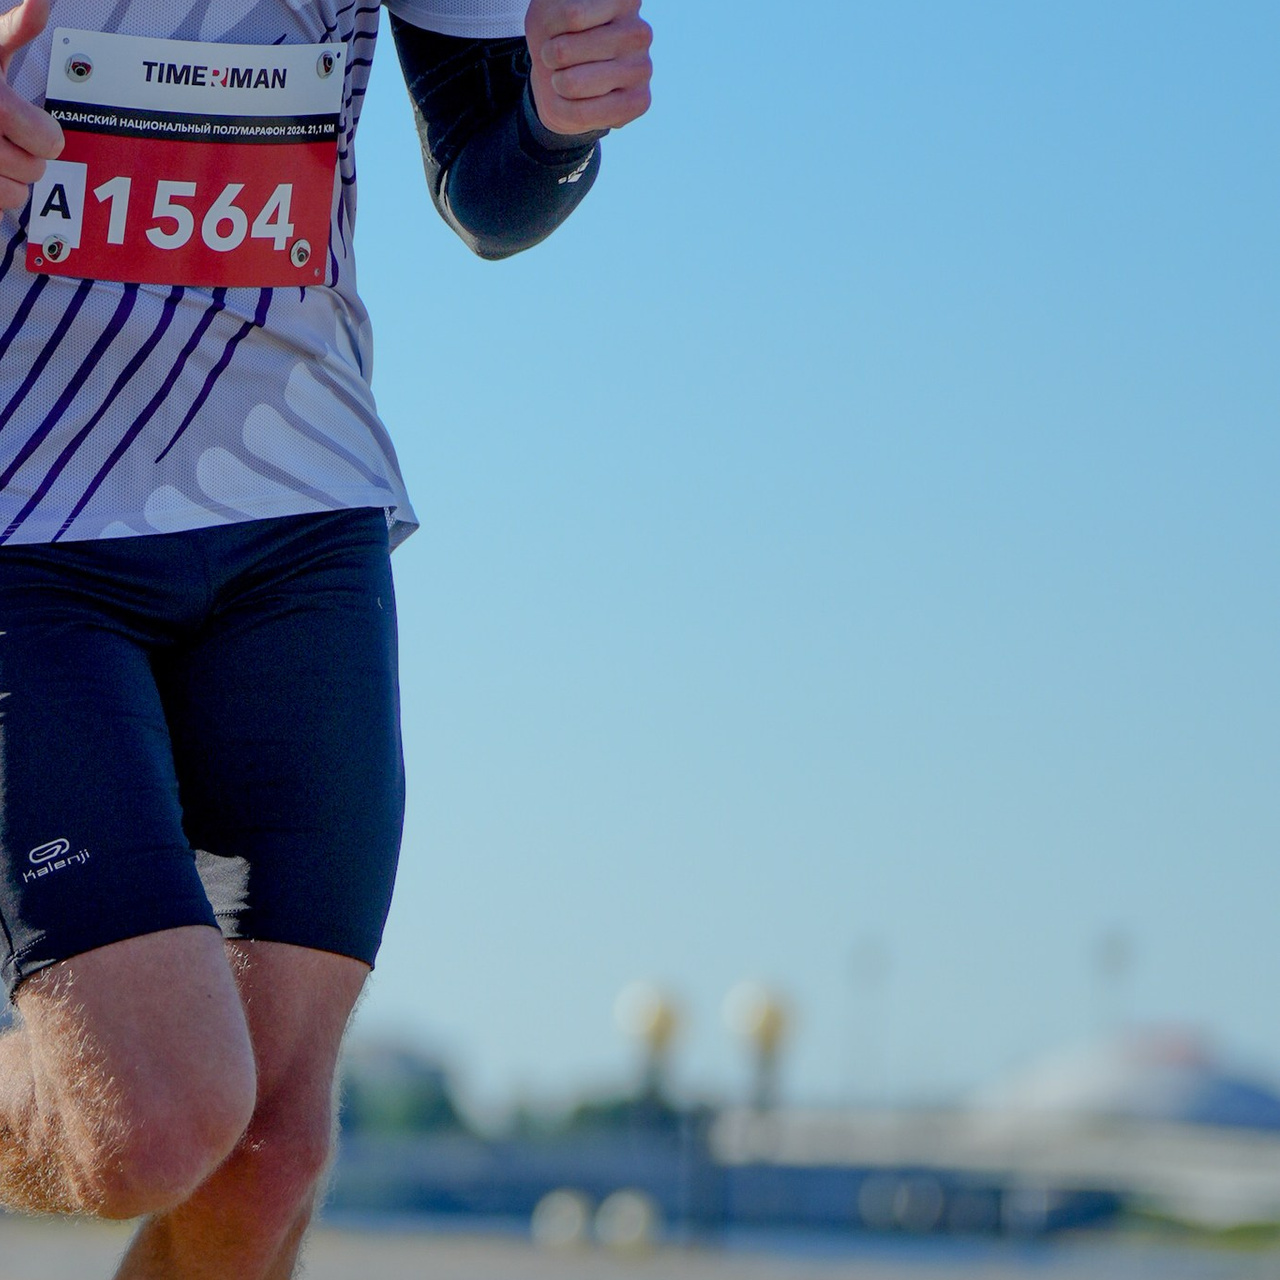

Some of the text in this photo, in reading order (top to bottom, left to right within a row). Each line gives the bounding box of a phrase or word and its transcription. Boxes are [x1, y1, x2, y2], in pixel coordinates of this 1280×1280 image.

[51, 109, 335, 136] КАЗАНСКИЙ НАЦИОНАЛЬНЫЙ ПОЛУМАРАФОН 2024. 21,1 КМ
[39, 176, 295, 253] A 1564
[23, 848, 90, 883] Kalenji
